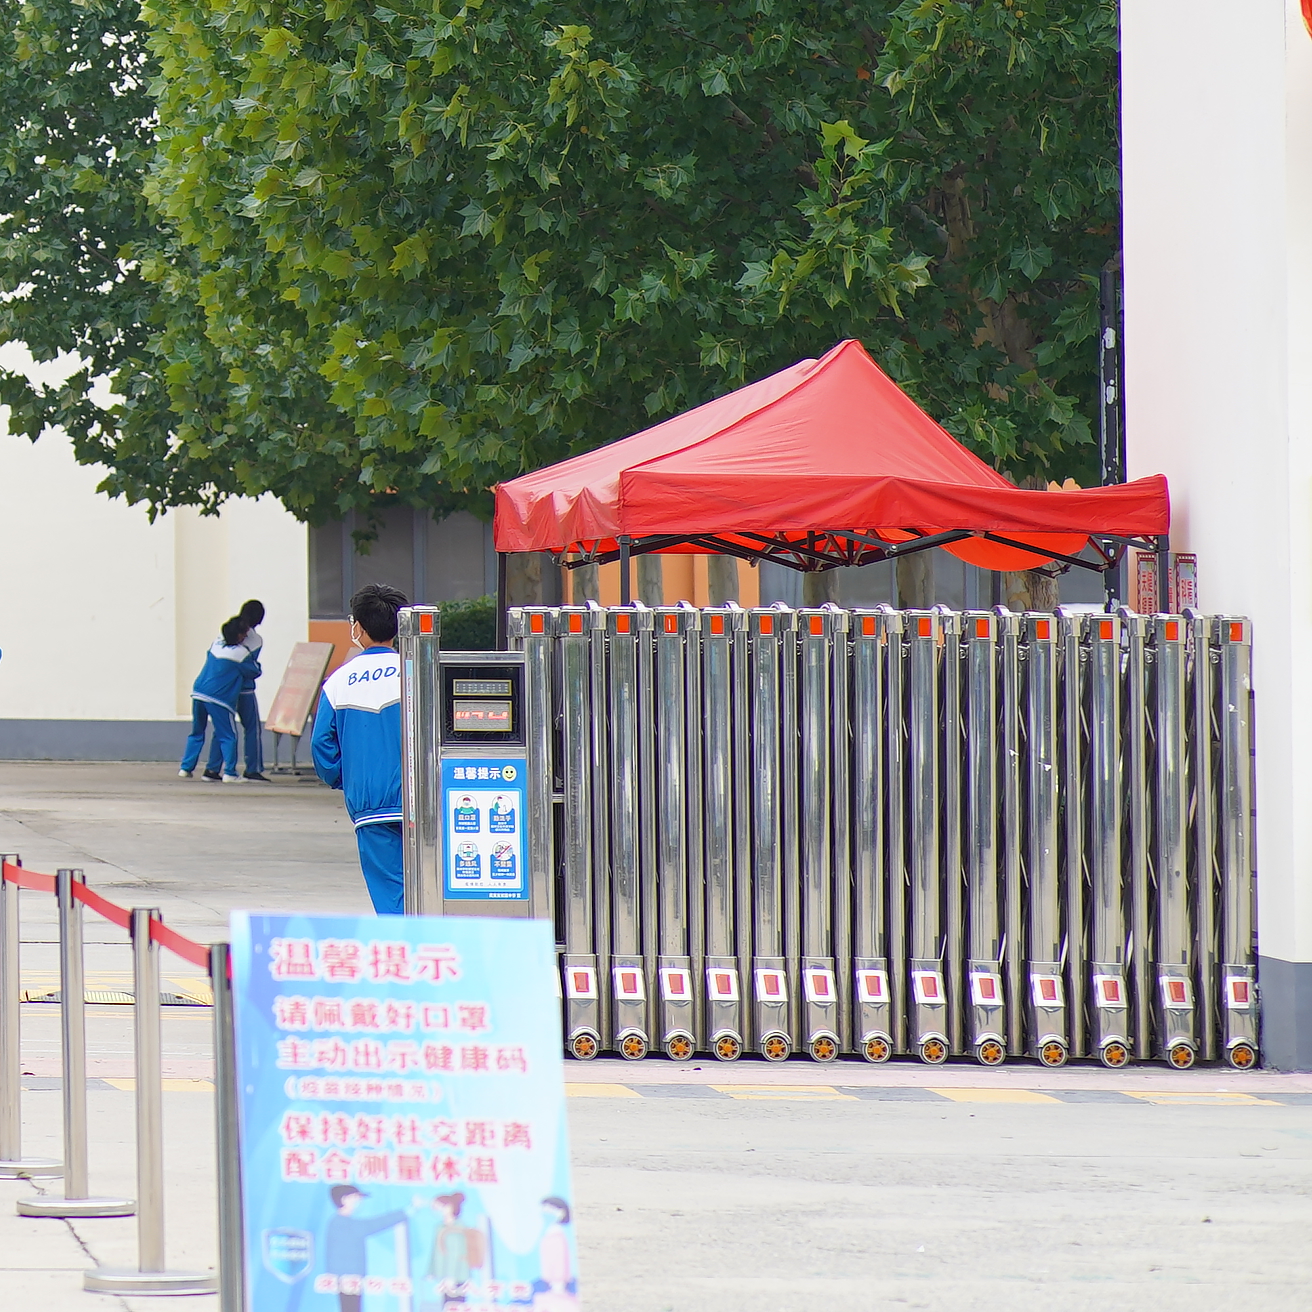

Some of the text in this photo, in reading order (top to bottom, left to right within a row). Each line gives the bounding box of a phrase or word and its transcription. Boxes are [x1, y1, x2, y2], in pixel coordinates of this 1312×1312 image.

[453, 766, 501, 780] 温馨提示
[271, 939, 459, 982] 温馨提示
[277, 998, 490, 1031] 请佩戴好口罩
[279, 1038, 529, 1073] 主动出示健康码
[283, 1115, 532, 1150] 保持好社交距离
[284, 1151, 498, 1184] 配合测量体温
